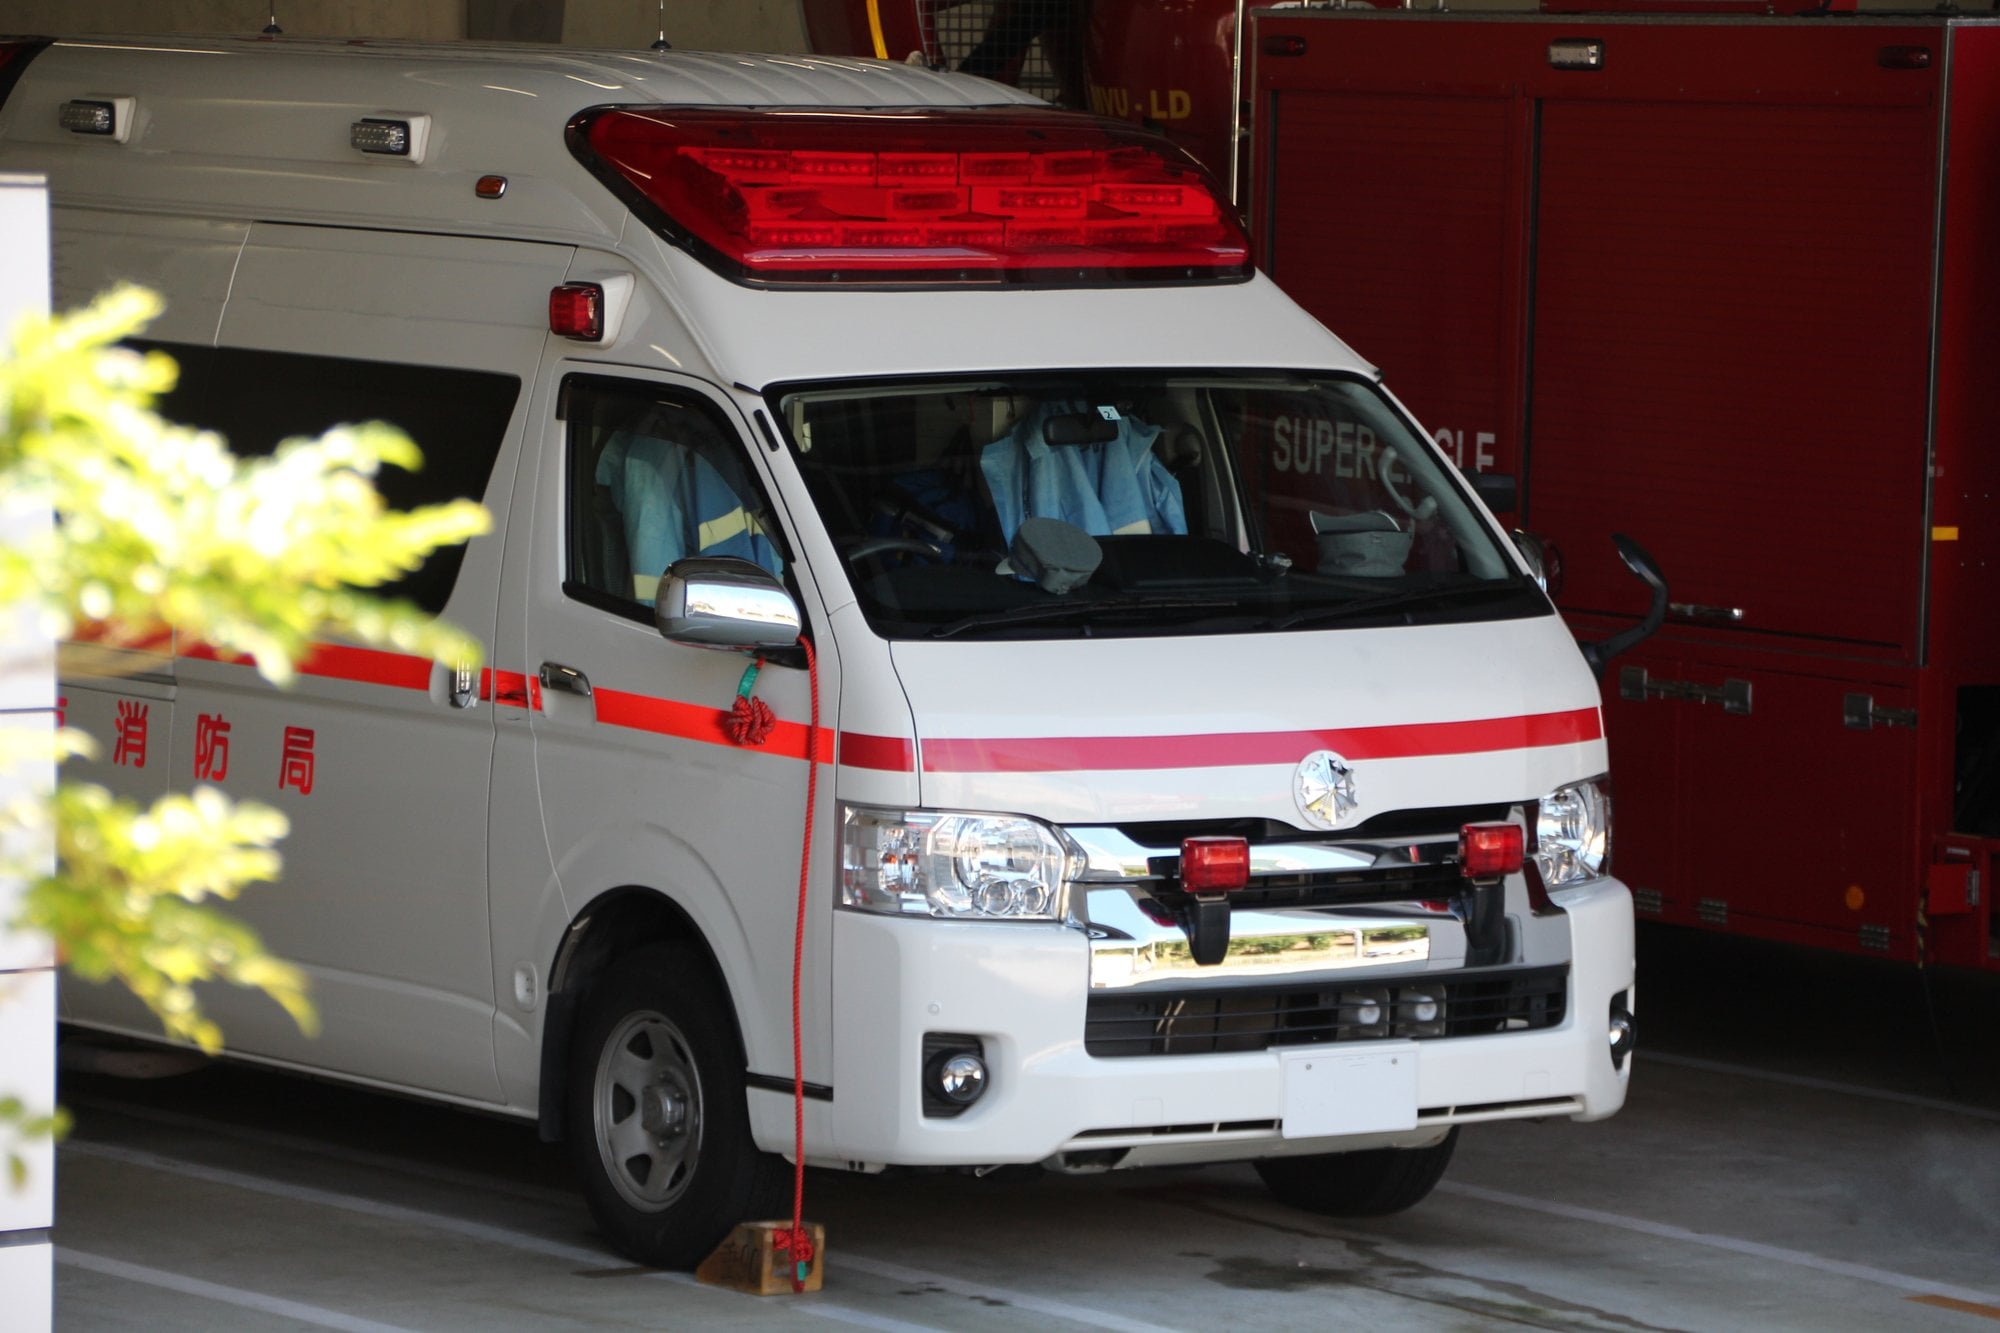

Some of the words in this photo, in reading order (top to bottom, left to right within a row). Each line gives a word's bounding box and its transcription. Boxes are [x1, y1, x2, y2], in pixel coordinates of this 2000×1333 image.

[1273, 415, 1377, 480] SUPER
[56, 697, 315, 795] 消防局
